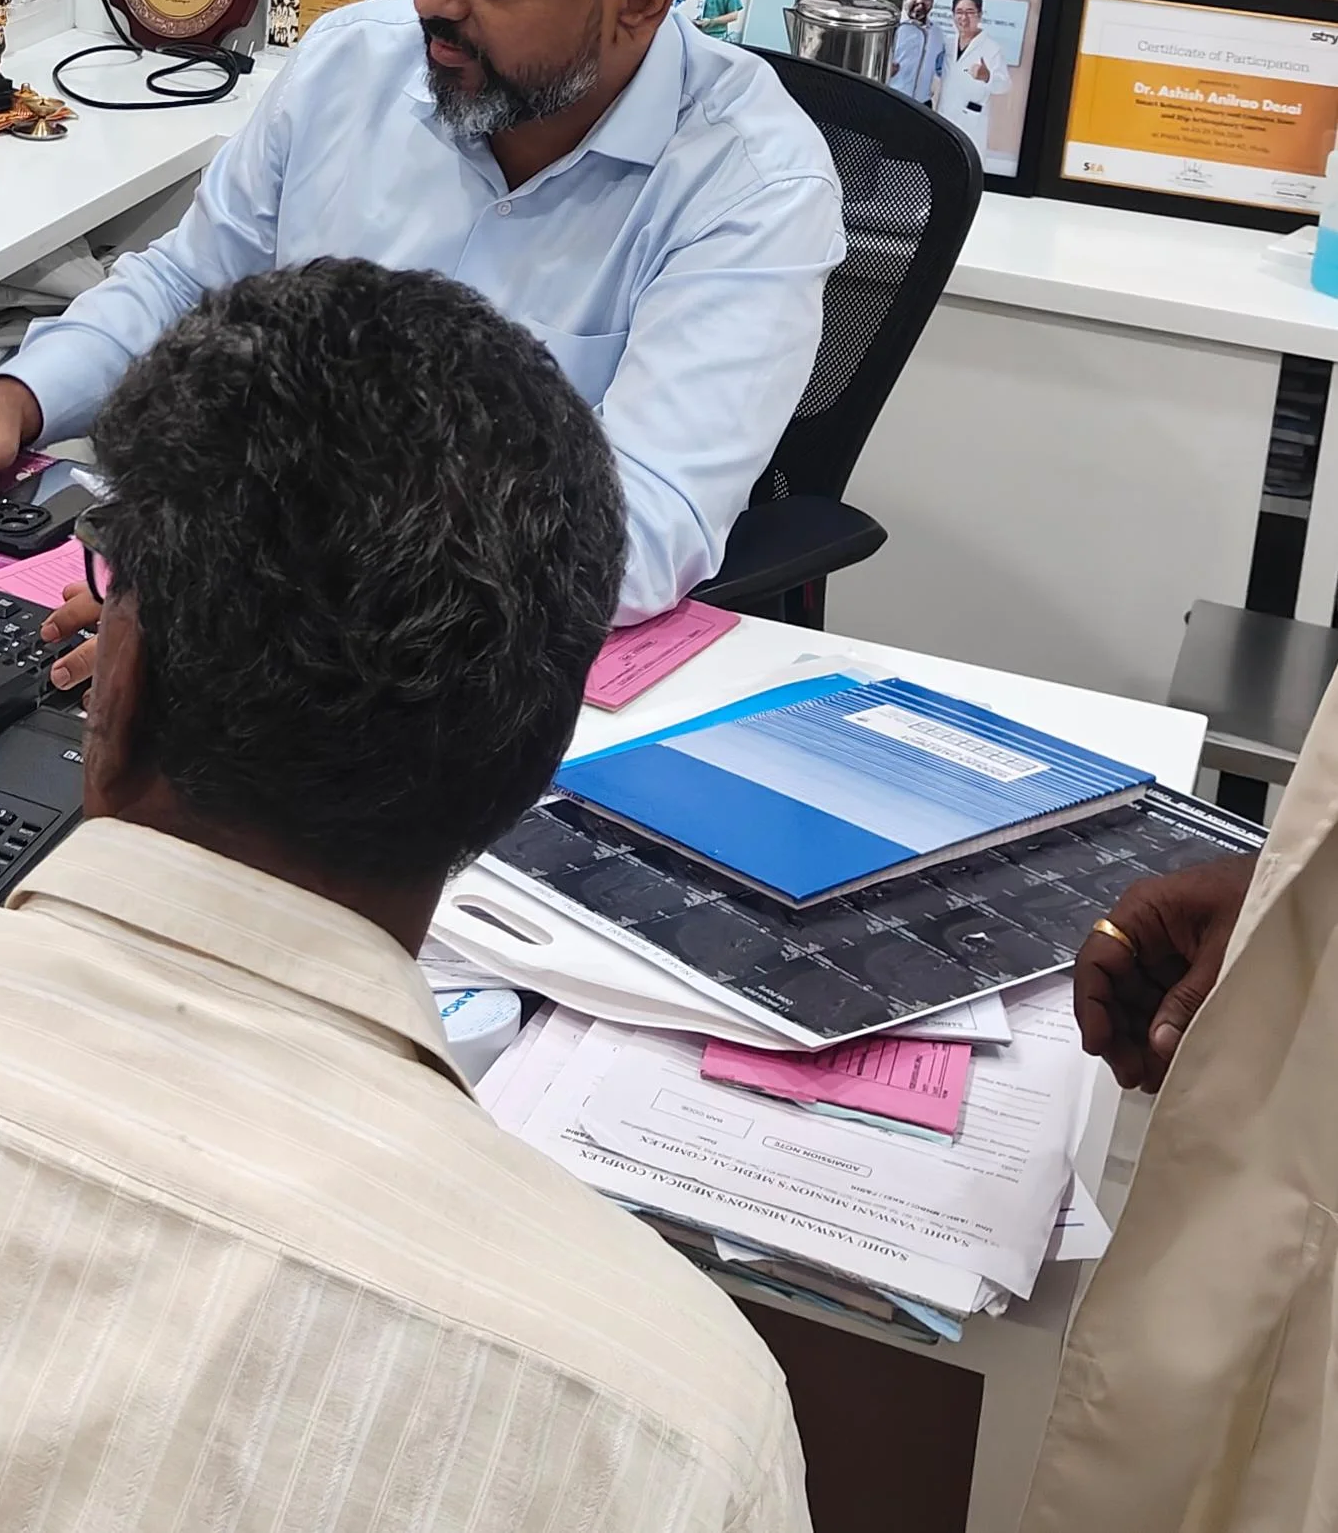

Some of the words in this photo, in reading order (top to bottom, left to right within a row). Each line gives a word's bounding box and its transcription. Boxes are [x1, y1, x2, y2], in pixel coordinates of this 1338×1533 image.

[1137, 39, 1206, 60] Certificate
[1209, 50, 1222, 61] of
[1226, 51, 1310, 73] Participation
[1133, 82, 1154, 96] Dr.
[1157, 85, 1204, 103] Ashish
[1206, 90, 1259, 110] Anilrao
[1262, 100, 1302, 115] Desai
[1084, 162, 1103, 173] SEA
[578, 1148, 648, 1177] COMPLEX
[639, 1134, 709, 1164] COMPLEX
[774, 1141, 801, 1157] NOTE
[803, 1148, 861, 1173] ADMISSION
[651, 1171, 714, 1198] MEDICAL
[709, 1156, 775, 1186] MEDICAL
[716, 1192, 788, 1222] MISSION'S
[779, 1181, 849, 1209] MISSION'S
[789, 1216, 855, 1245] VASWANI
[851, 1202, 917, 1232] VASWANI
[857, 1239, 909, 1263] SADHU
[921, 1227, 970, 1248] SADHU
